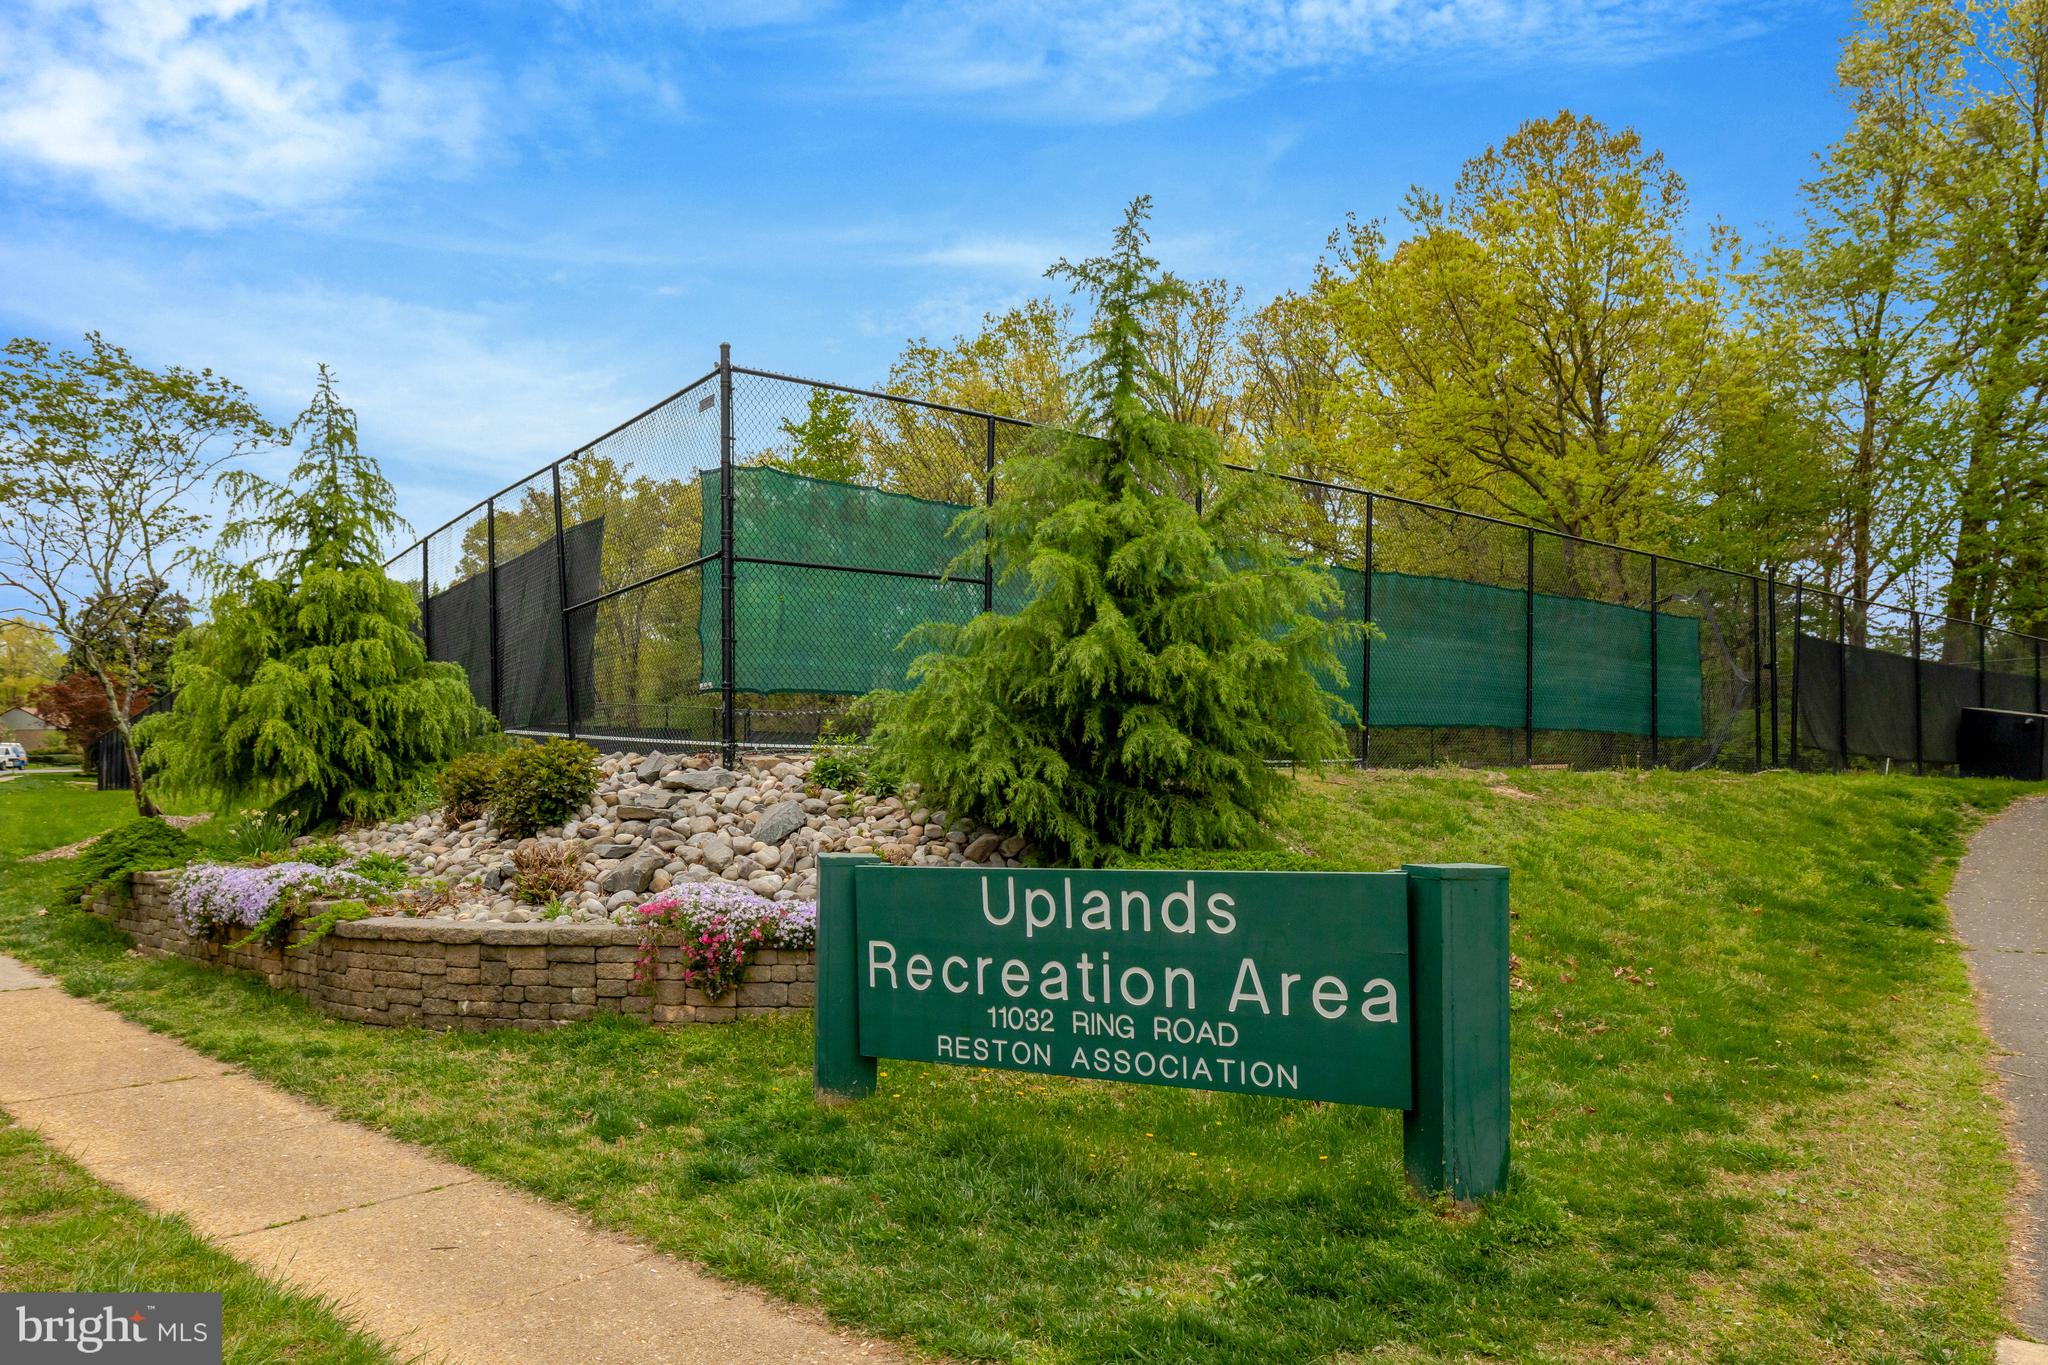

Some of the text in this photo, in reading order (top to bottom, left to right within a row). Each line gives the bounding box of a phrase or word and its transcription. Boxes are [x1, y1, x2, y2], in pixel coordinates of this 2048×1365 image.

[980, 876, 1237, 938] Uplands
[868, 940, 1398, 1023] Recreation Area
[987, 1006, 1239, 1047] 11032 RING ROAD
[937, 1035, 1298, 1090] RESTON ASSOCIATION
